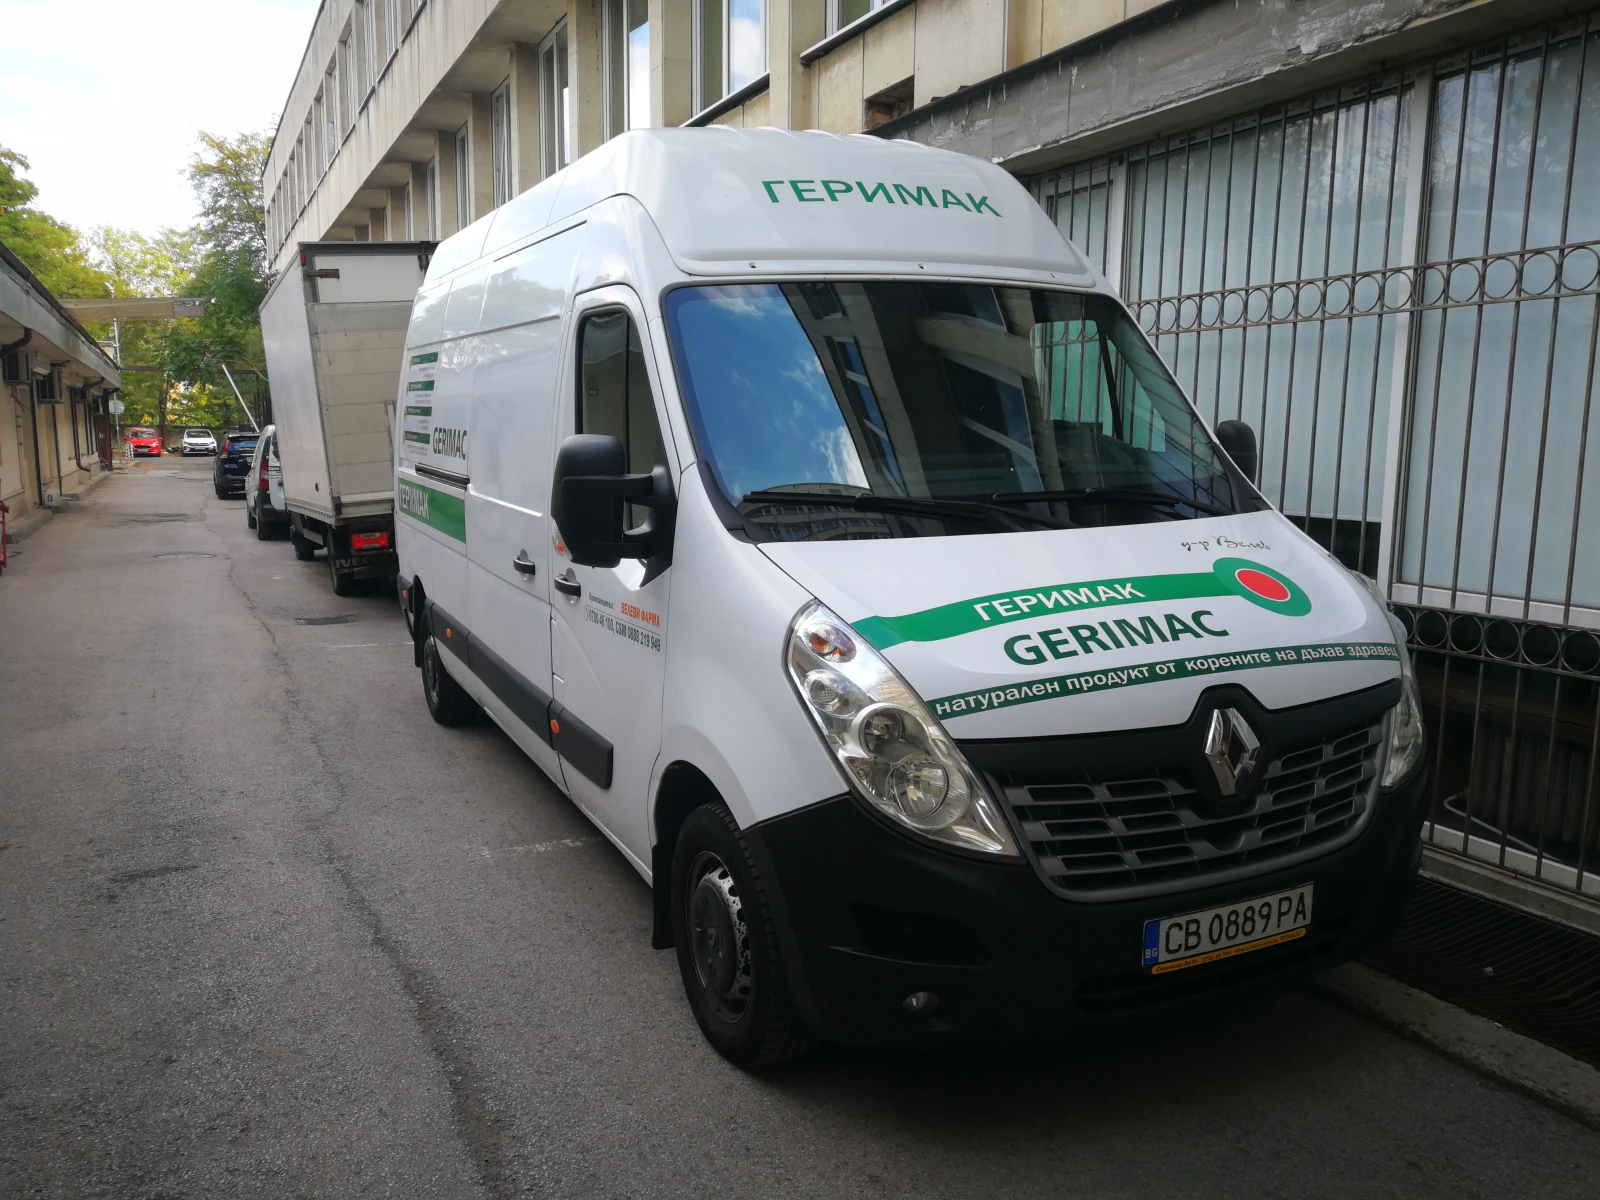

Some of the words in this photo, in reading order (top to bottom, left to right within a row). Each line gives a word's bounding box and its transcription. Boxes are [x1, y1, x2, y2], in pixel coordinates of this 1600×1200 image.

[761, 179, 1003, 218] ГЕРИМАК
[433, 426, 467, 461] GERIMAC
[399, 485, 430, 520] ГЕРИМАК
[621, 602, 641, 620] ВЕЛЕВИ
[641, 608, 660, 628] ФАРМА
[973, 582, 1146, 621] ГЕРИМАК
[615, 621, 627, 638] GSM
[640, 631, 650, 648] 219
[650, 636, 661, 653] 949
[1004, 609, 1230, 666] GERIMAC
[935, 680, 1060, 715] натурален
[1066, 666, 1150, 692] продукт
[1155, 662, 1177, 675] от
[1185, 651, 1271, 671] корените
[1276, 649, 1297, 662] на
[1301, 644, 1345, 660] дъхав
[1347, 644, 1398, 658] здравец
[1164, 918, 1202, 955] CB
[1208, 901, 1272, 945] 0889
[1276, 891, 1307, 929] PA
[1145, 948, 1158, 959] BG
